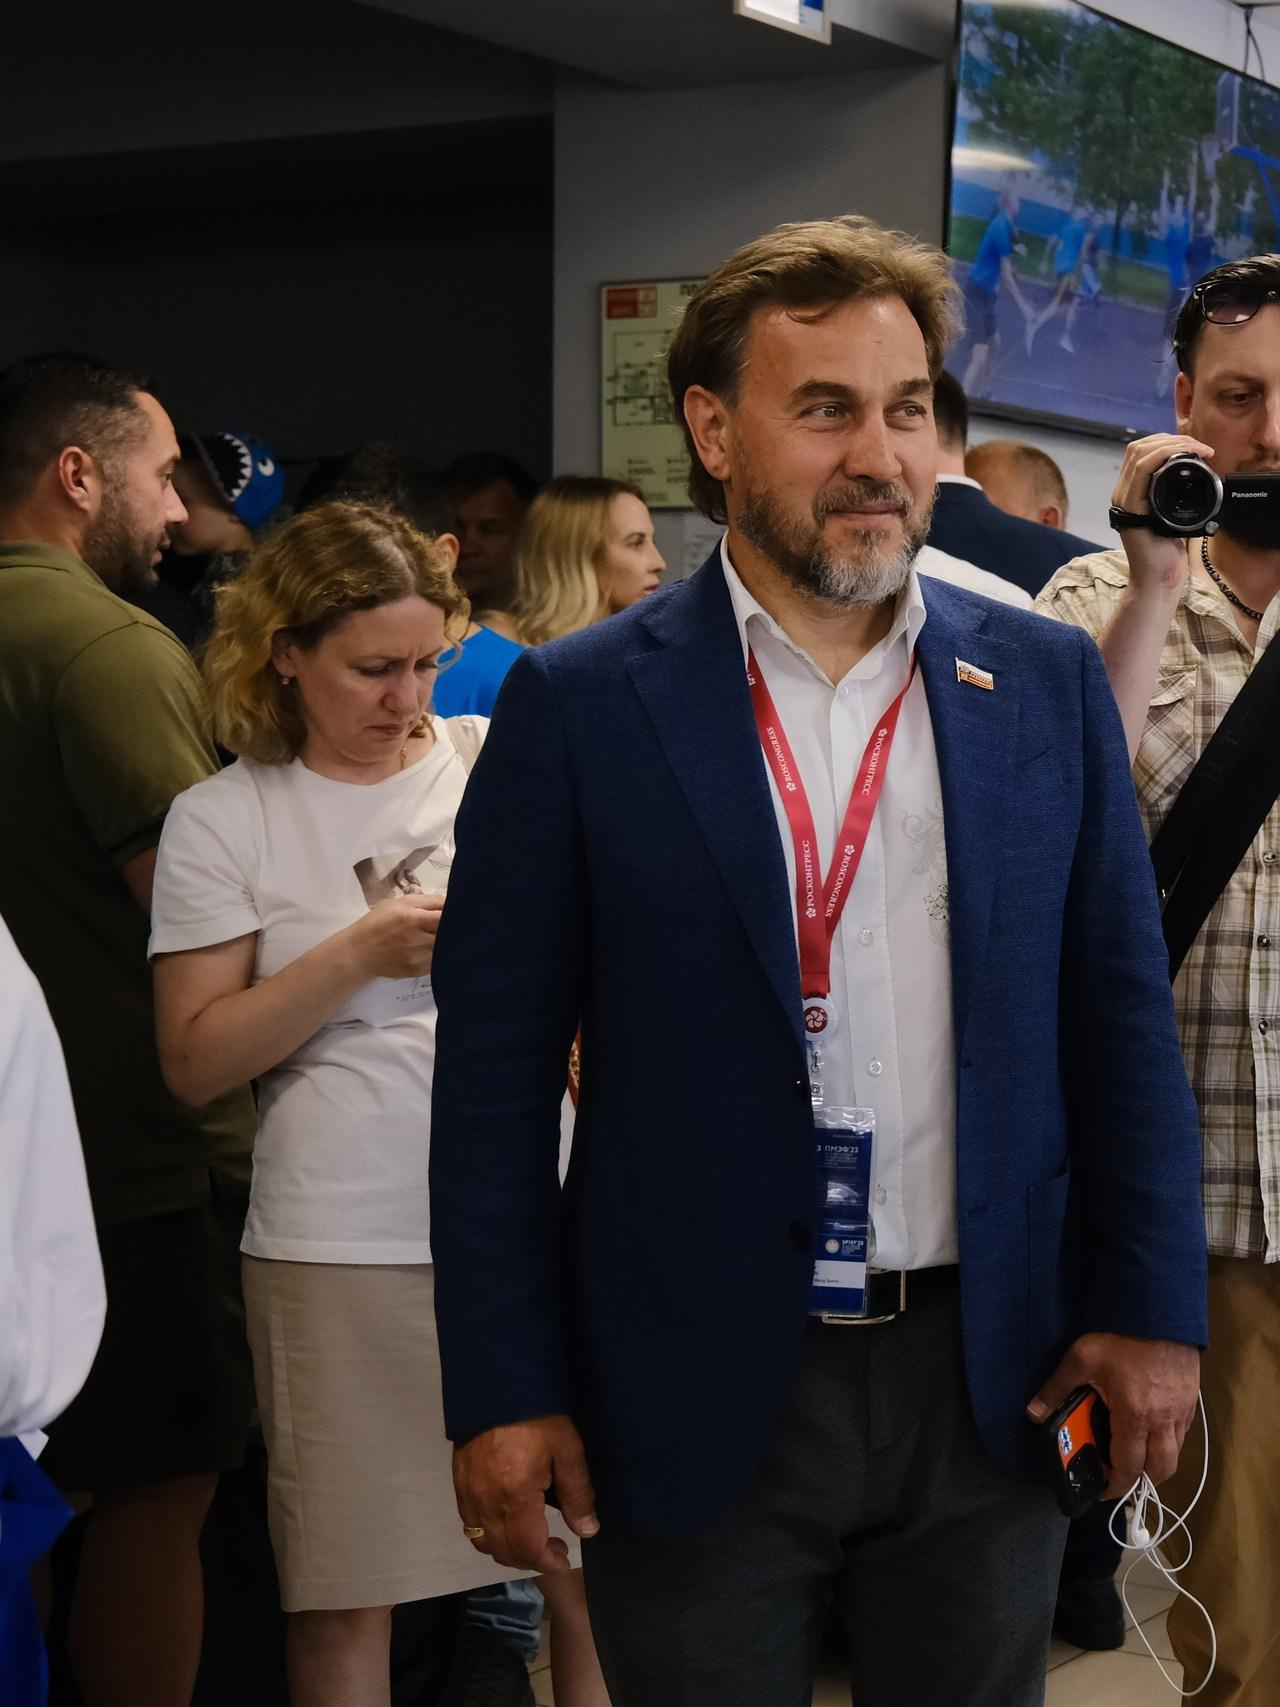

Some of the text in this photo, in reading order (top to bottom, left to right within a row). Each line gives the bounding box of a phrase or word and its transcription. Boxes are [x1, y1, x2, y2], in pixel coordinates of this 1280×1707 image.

[766, 726, 793, 782] ROSCONGRESS
[802, 839, 815, 907] РОСКОНГРЕСС
[825, 854, 852, 918] ROSCONGRESS
